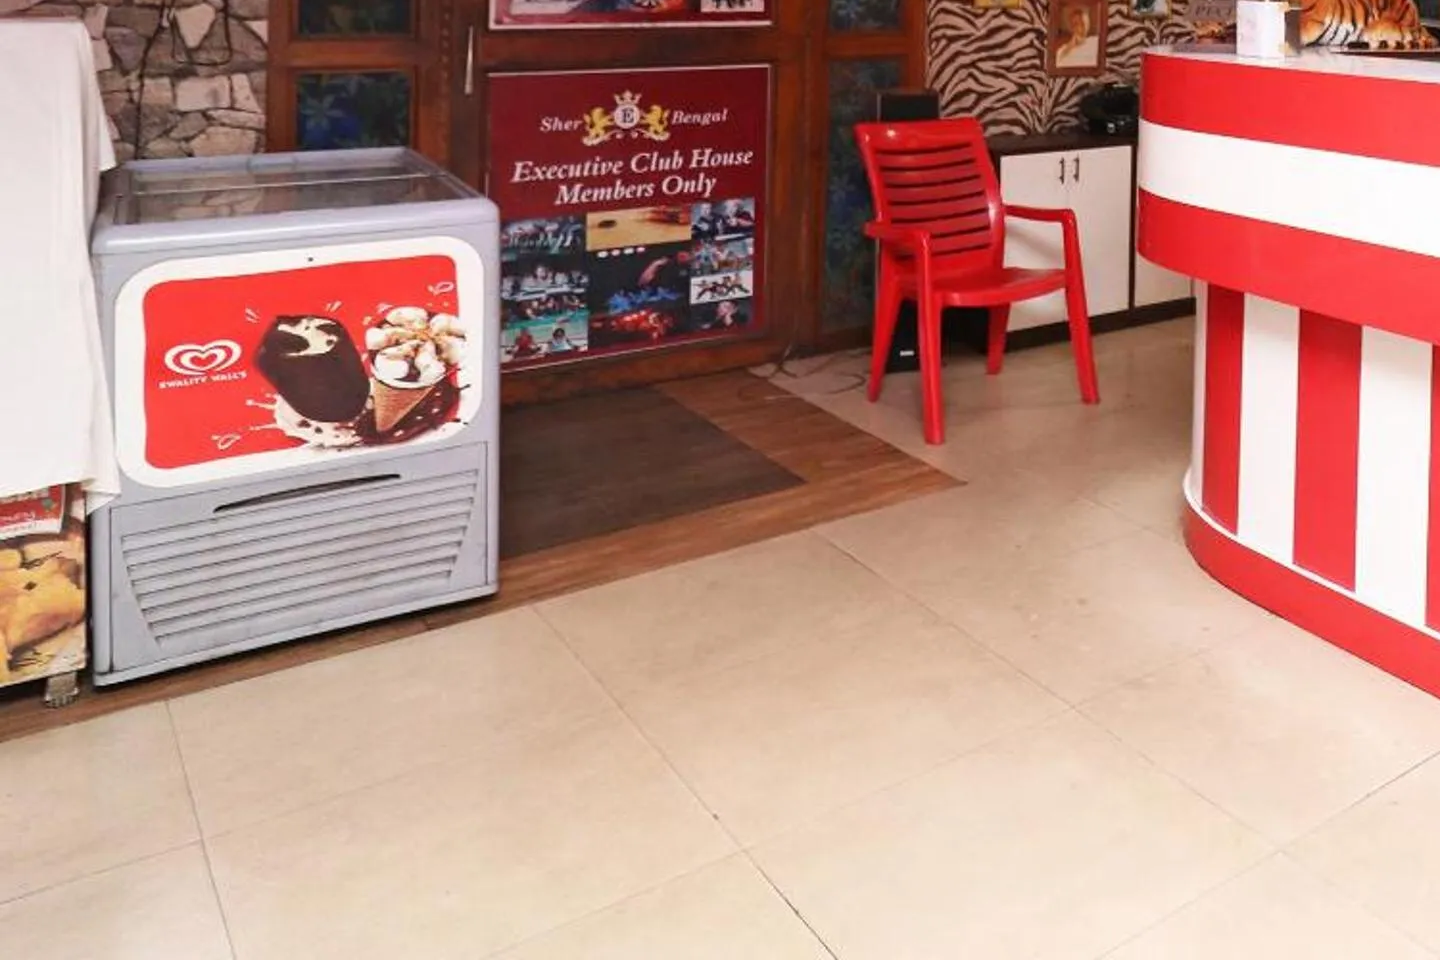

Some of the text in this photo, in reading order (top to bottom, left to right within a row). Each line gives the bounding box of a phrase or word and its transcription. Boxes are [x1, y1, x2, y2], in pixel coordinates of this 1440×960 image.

[539, 117, 583, 132] Sher
[671, 109, 728, 126] Bengal
[511, 148, 754, 183] Executive Club House
[554, 173, 717, 205] Members Only
